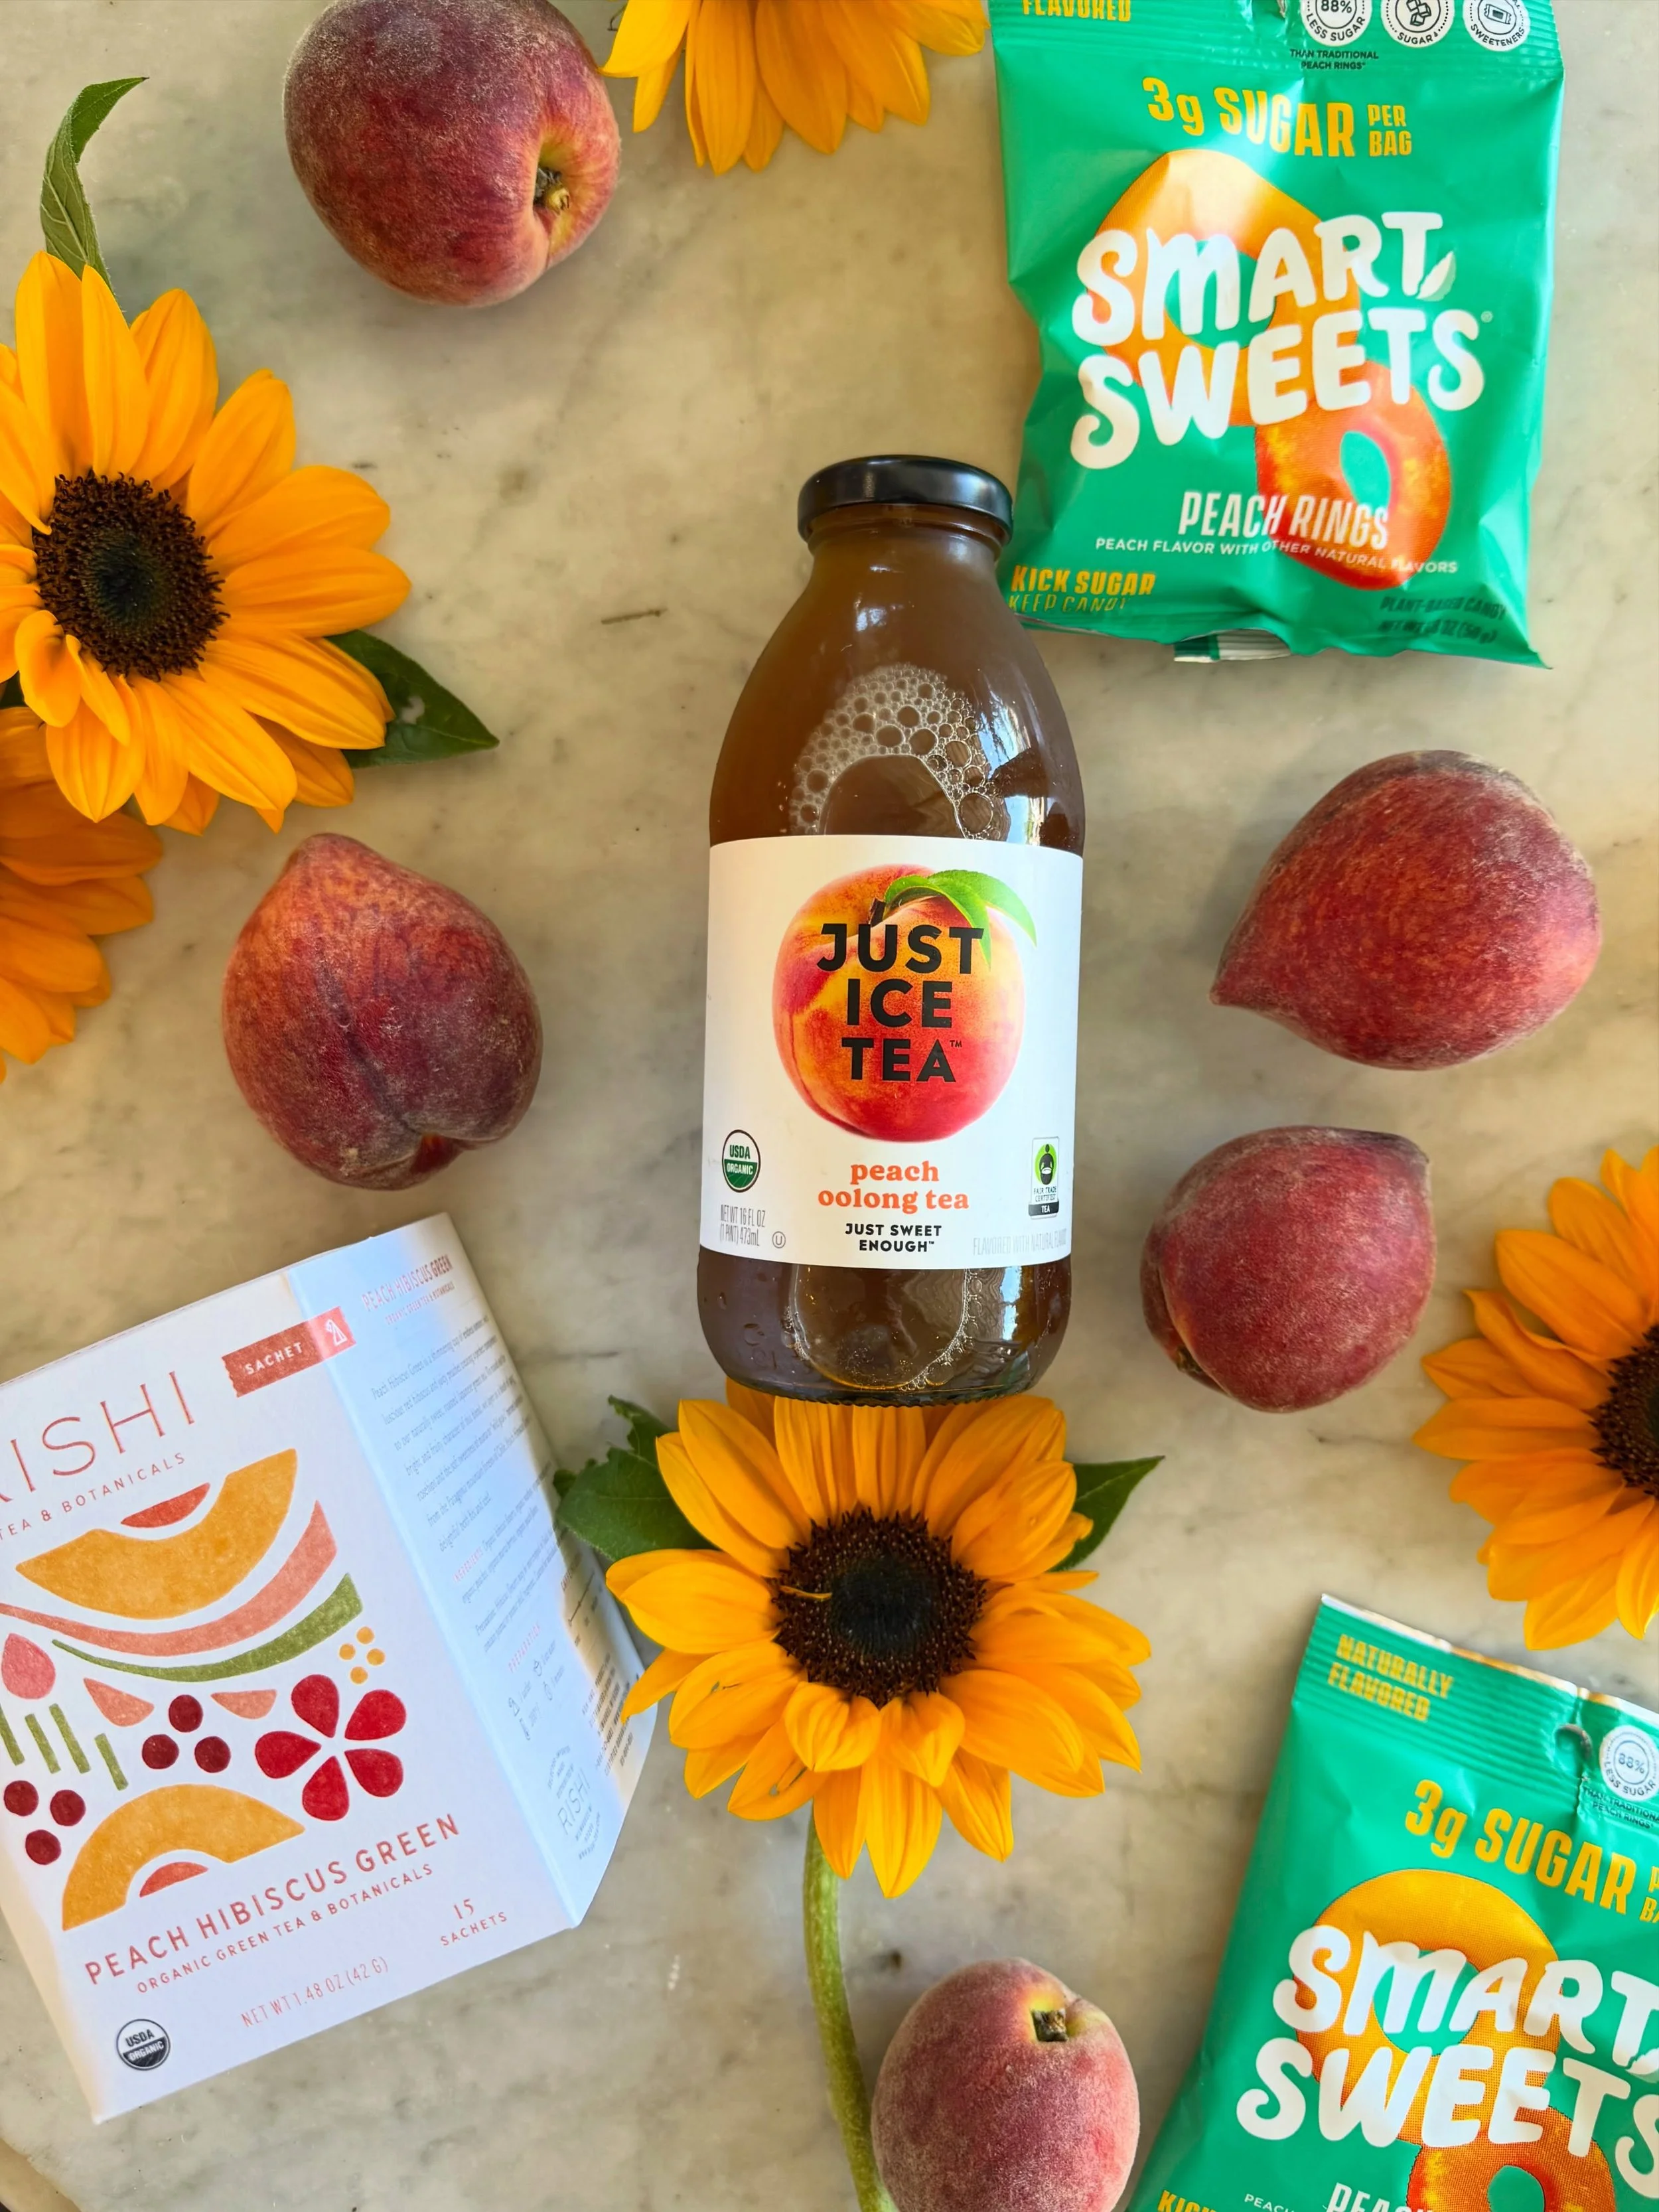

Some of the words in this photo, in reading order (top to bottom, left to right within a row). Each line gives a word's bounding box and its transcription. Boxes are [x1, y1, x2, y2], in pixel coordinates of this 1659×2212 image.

[1023, 0, 1131, 21] FLAVORED
[1321, 0, 1352, 13] 88%
[1306, 13, 1328, 38] LESS
[1330, 17, 1366, 41] SUGAR
[1471, 23, 1525, 46] SWEETENERS
[1290, 48, 1315, 58] THAN
[1316, 50, 1379, 60] TRADITIONAL
[1301, 60, 1331, 70] PEACH
[1142, 78, 1204, 137] 3g
[1214, 86, 1356, 158] SUGAR
[1368, 104, 1407, 127] PER
[1369, 130, 1412, 158] BAG
[1072, 211, 1453, 347] SMART
[1070, 307, 1485, 469] SWEETS
[1177, 490, 1289, 539] PEACH
[1290, 494, 1390, 551] RINGS
[1096, 537, 1148, 552] PEACH
[1153, 538, 1214, 555] FLAVOR
[1220, 541, 1260, 555] WITH
[1262, 540, 1311, 555] OTHER
[1314, 548, 1387, 571] NATURAL
[1391, 556, 1458, 575] FLAVORS
[1011, 565, 1070, 593] KICK
[1074, 569, 1156, 596] SUGAR
[816, 922, 984, 974] JUST
[847, 979, 953, 1029] ICE
[729, 1144, 751, 1160] USDA
[727, 1162, 754, 1176] ORGANIC
[850, 1160, 939, 1185] peach
[818, 1188, 919, 1215] oolong
[926, 1189, 970, 1210] tea
[1045, 1185, 1056, 1194] TRADE
[721, 1204, 730, 1222] NET
[730, 1206, 739, 1225] WT
[740, 1207, 747, 1226] 16
[748, 1209, 755, 1227] FL
[757, 1210, 766, 1228] OZ
[1041, 1205, 1050, 1213] TEA
[739, 1228, 760, 1247] 473mL
[845, 1222, 885, 1236] JUST
[891, 1224, 942, 1237] SWEET
[973, 1236, 1011, 1256] FLAVORED
[1012, 1234, 1030, 1254] WITH
[362, 1284, 397, 1312] PEACH
[395, 1264, 434, 1297] HIBISCUS
[430, 1254, 455, 1278] GREEN
[244, 1342, 304, 1376] SACHET
[0, 1370, 194, 1503] ISHI
[40, 1509, 52, 1522] &
[61, 1451, 186, 1513] BOTANICALS
[1335, 1633, 1455, 1699] NATURALLY
[1328, 1662, 1431, 1722] FLAVORED
[1618, 1752, 1645, 1774] 88%
[1604, 1761, 1621, 1789] LESS
[1623, 1779, 1656, 1796] SUGAR
[557, 1767, 591, 1836] RISHI
[1593, 1801, 1623, 1819] PEACH
[1609, 1796, 1659, 1822] TRADITIONA
[1405, 1779, 1467, 1859] 3g
[1475, 1807, 1636, 1915] SUGAR
[85, 1925, 189, 1985] PEACH
[196, 1861, 348, 1940] HIBISCUS
[354, 1813, 461, 1874] GREEN
[453, 1898, 474, 1920] 15
[137, 1954, 212, 1994] ORGANIC
[216, 1931, 269, 1962] GREEN
[273, 1915, 307, 1938] TEA
[311, 1909, 322, 1922] &
[327, 1863, 434, 1915] BOTANICALS
[440, 1911, 508, 1947] SACHETS
[241, 2003, 269, 2028] NET
[271, 1994, 292, 2018] WT
[293, 1980, 325, 2008] 1.48
[325, 1972, 346, 1994] OZ
[346, 1961, 368, 1988] (42
[370, 1955, 389, 1976] G)
[1273, 1925, 1659, 2075] SMART
[125, 2028, 155, 2047] USDA
[129, 2039, 165, 2061] ORGANIC
[1236, 2036, 1659, 2199] SWEETS
[1244, 2193, 1294, 2212] PEAC
